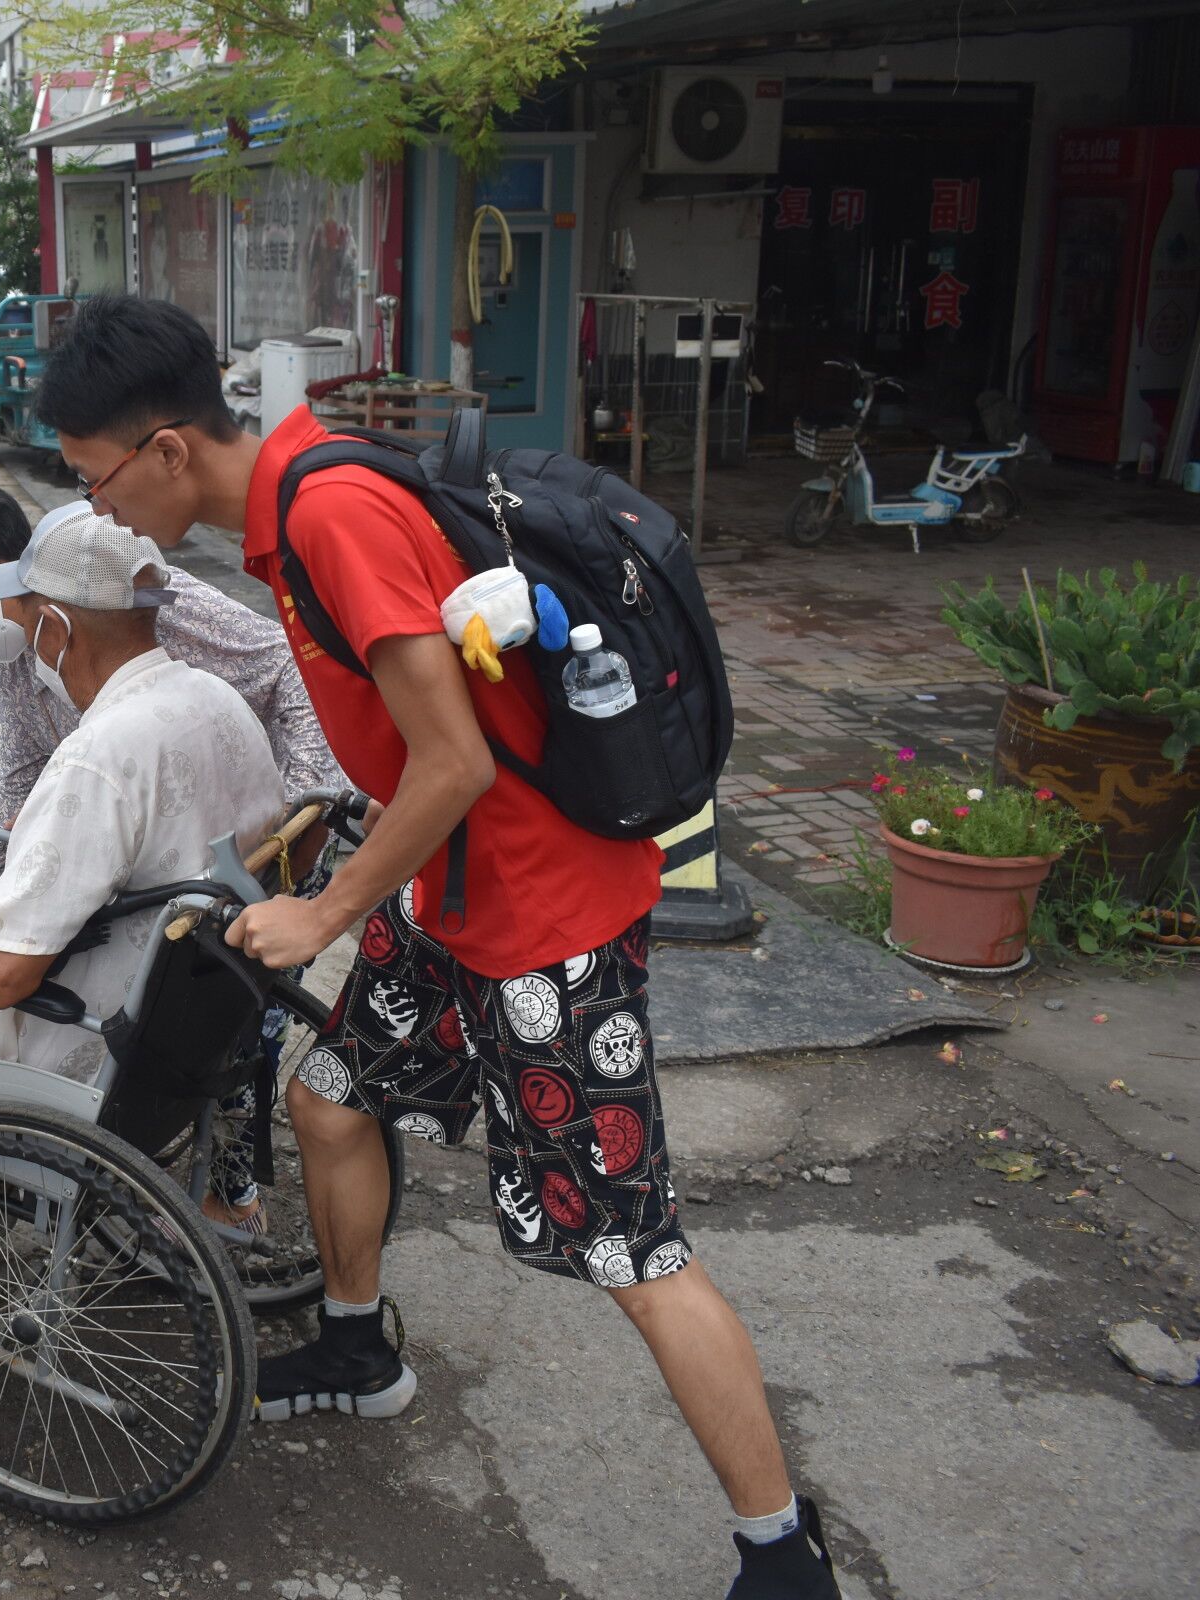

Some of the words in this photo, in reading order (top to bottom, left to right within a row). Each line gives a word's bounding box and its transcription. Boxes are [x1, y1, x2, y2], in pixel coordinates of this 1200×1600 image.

[1062, 137, 1121, 161] 农夫山泉
[773, 184, 867, 231] 复印
[918, 176, 981, 330] 副食
